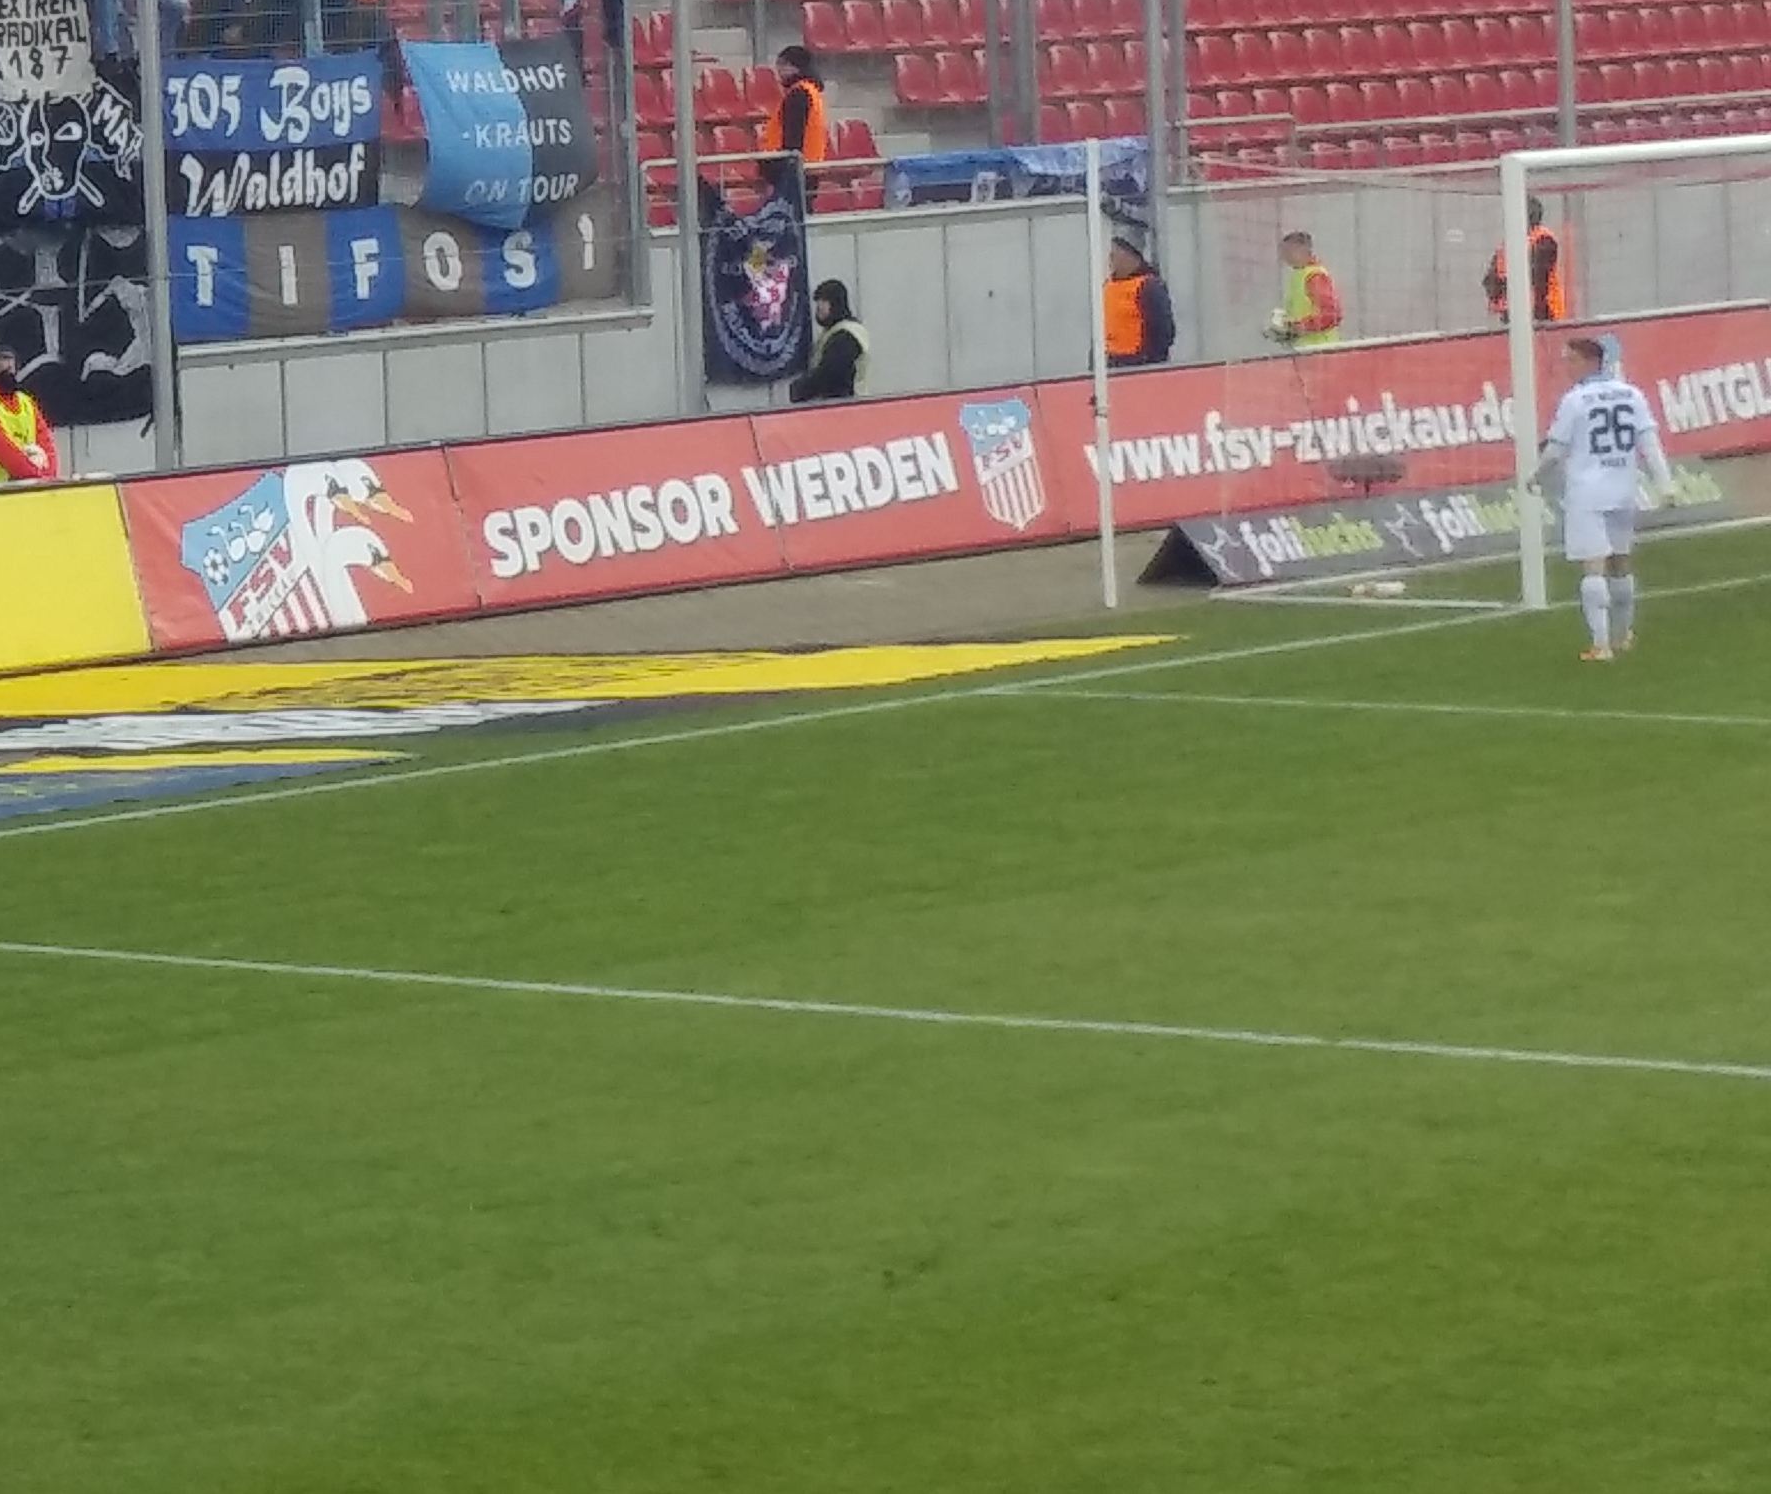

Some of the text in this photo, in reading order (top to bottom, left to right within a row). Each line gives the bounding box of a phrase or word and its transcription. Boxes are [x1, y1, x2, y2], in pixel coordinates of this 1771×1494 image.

[9, 45, 73, 81] 187
[446, 62, 568, 94] WALDHOF
[260, 65, 372, 144] Boys
[179, 141, 367, 218] Waldhof
[518, 172, 581, 205] TOUR
[1588, 403, 1636, 455] 26
[482, 429, 959, 581] SPONSOR WERDEN
